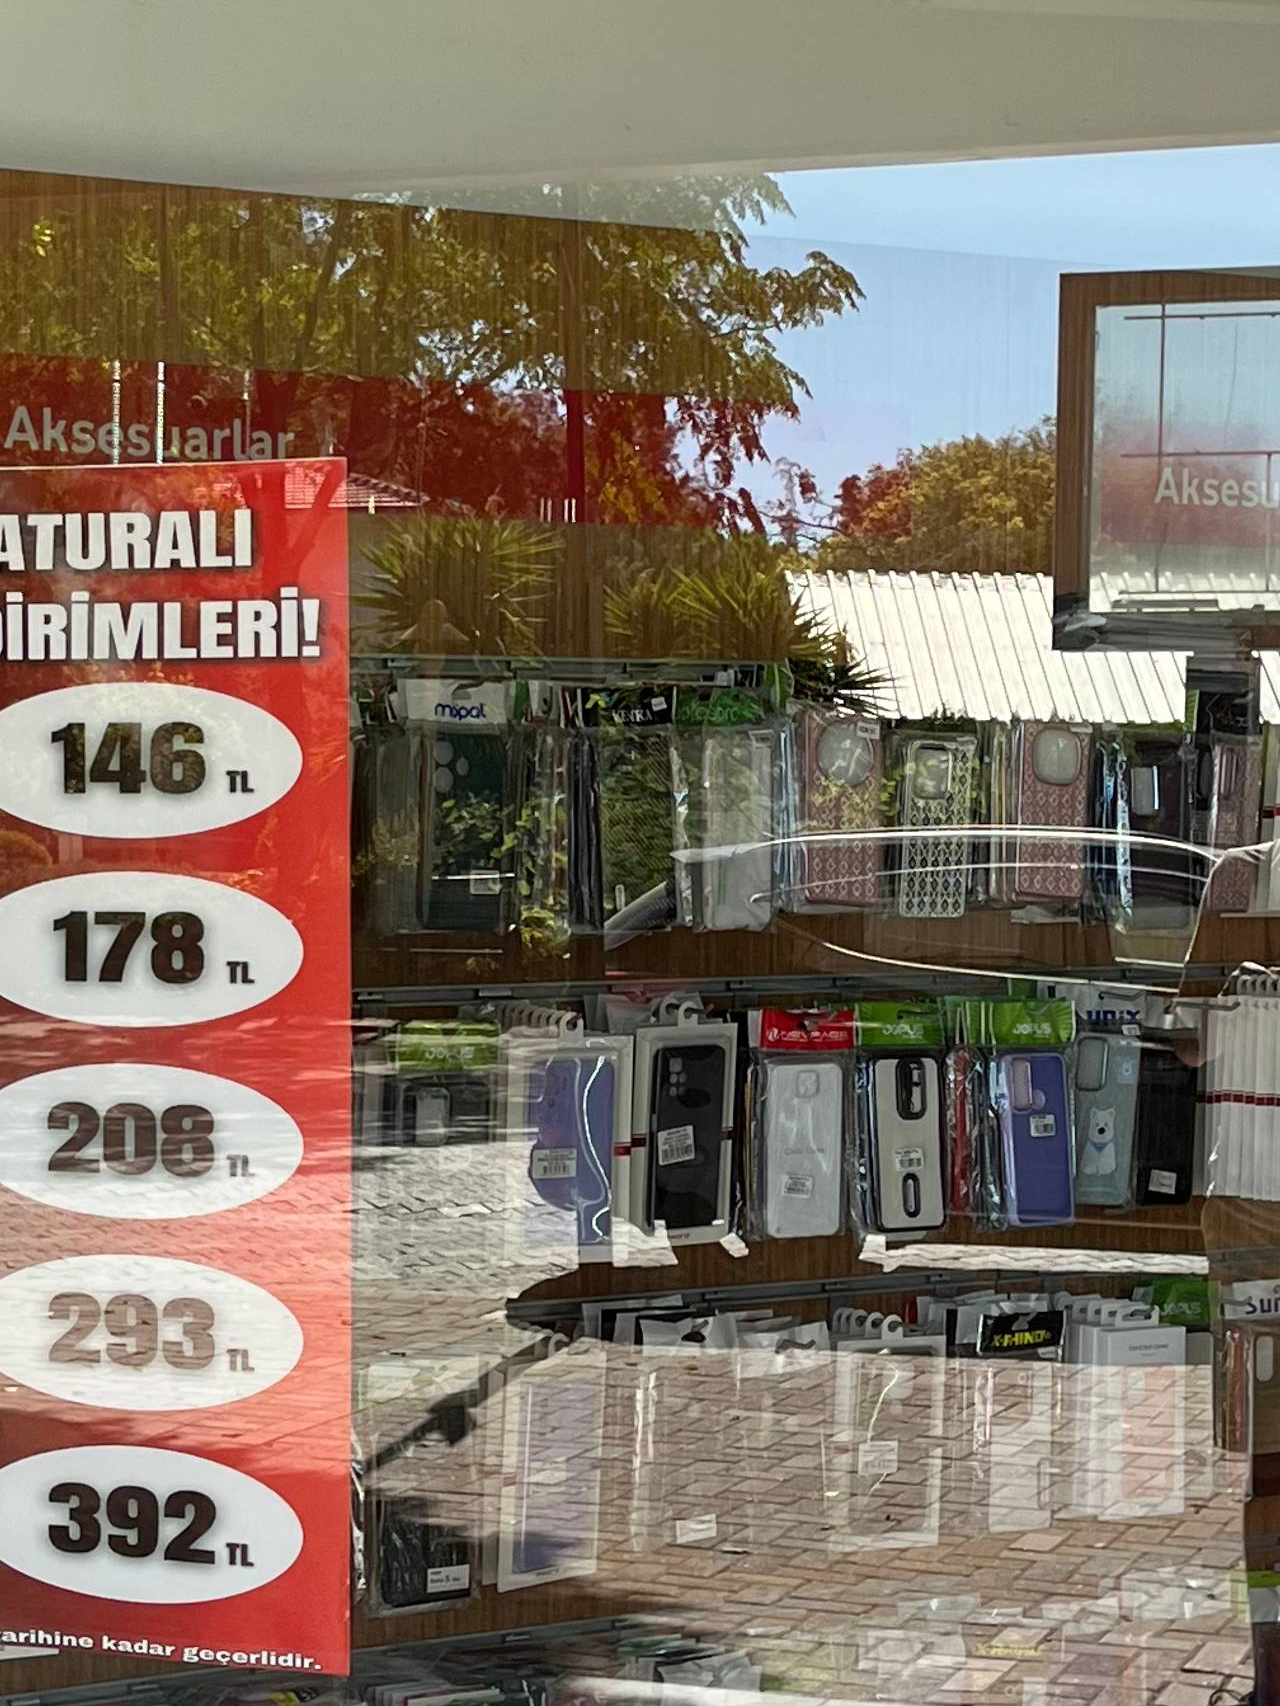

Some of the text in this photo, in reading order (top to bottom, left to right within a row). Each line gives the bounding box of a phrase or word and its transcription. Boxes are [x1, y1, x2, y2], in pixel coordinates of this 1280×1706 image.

[50, 720, 255, 796] 146 TL
[51, 909, 255, 985] 178 TL
[46, 1100, 255, 1178] 208 TL
[47, 1290, 255, 1373] 293 TL
[47, 1480, 254, 1567] 392 TL
[101, 1634, 175, 1657] kadar
[182, 1644, 322, 1671] geçerlidir.
